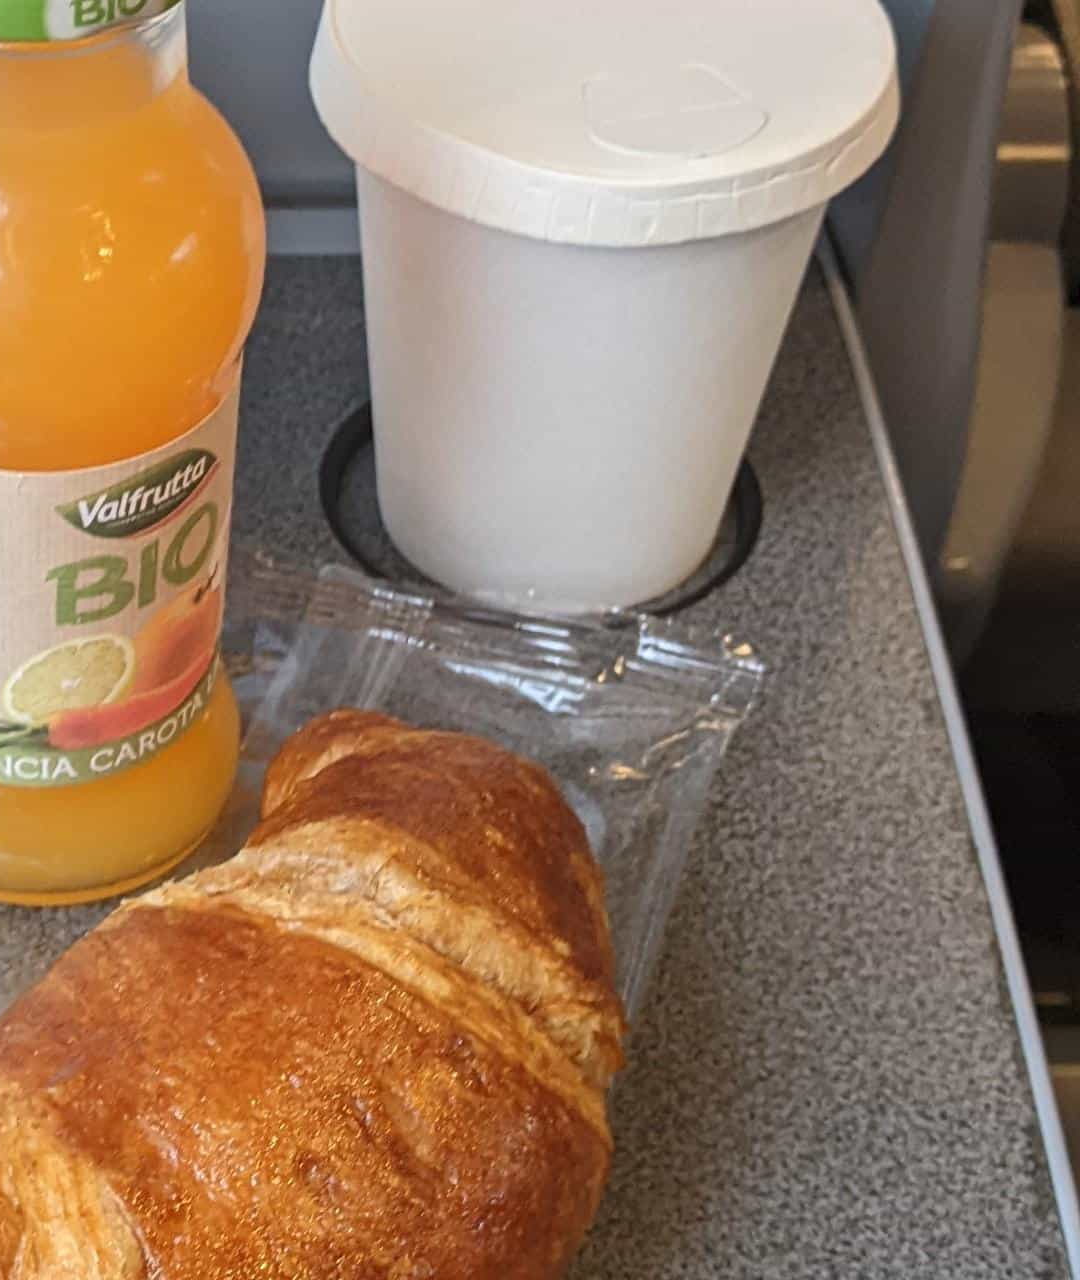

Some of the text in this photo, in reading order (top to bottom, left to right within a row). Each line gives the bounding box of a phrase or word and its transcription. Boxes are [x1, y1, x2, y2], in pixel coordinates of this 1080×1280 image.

[78, 455, 207, 528] Valfrutta
[45, 502, 218, 627] BIO
[89, 693, 203, 772] CAROTA
